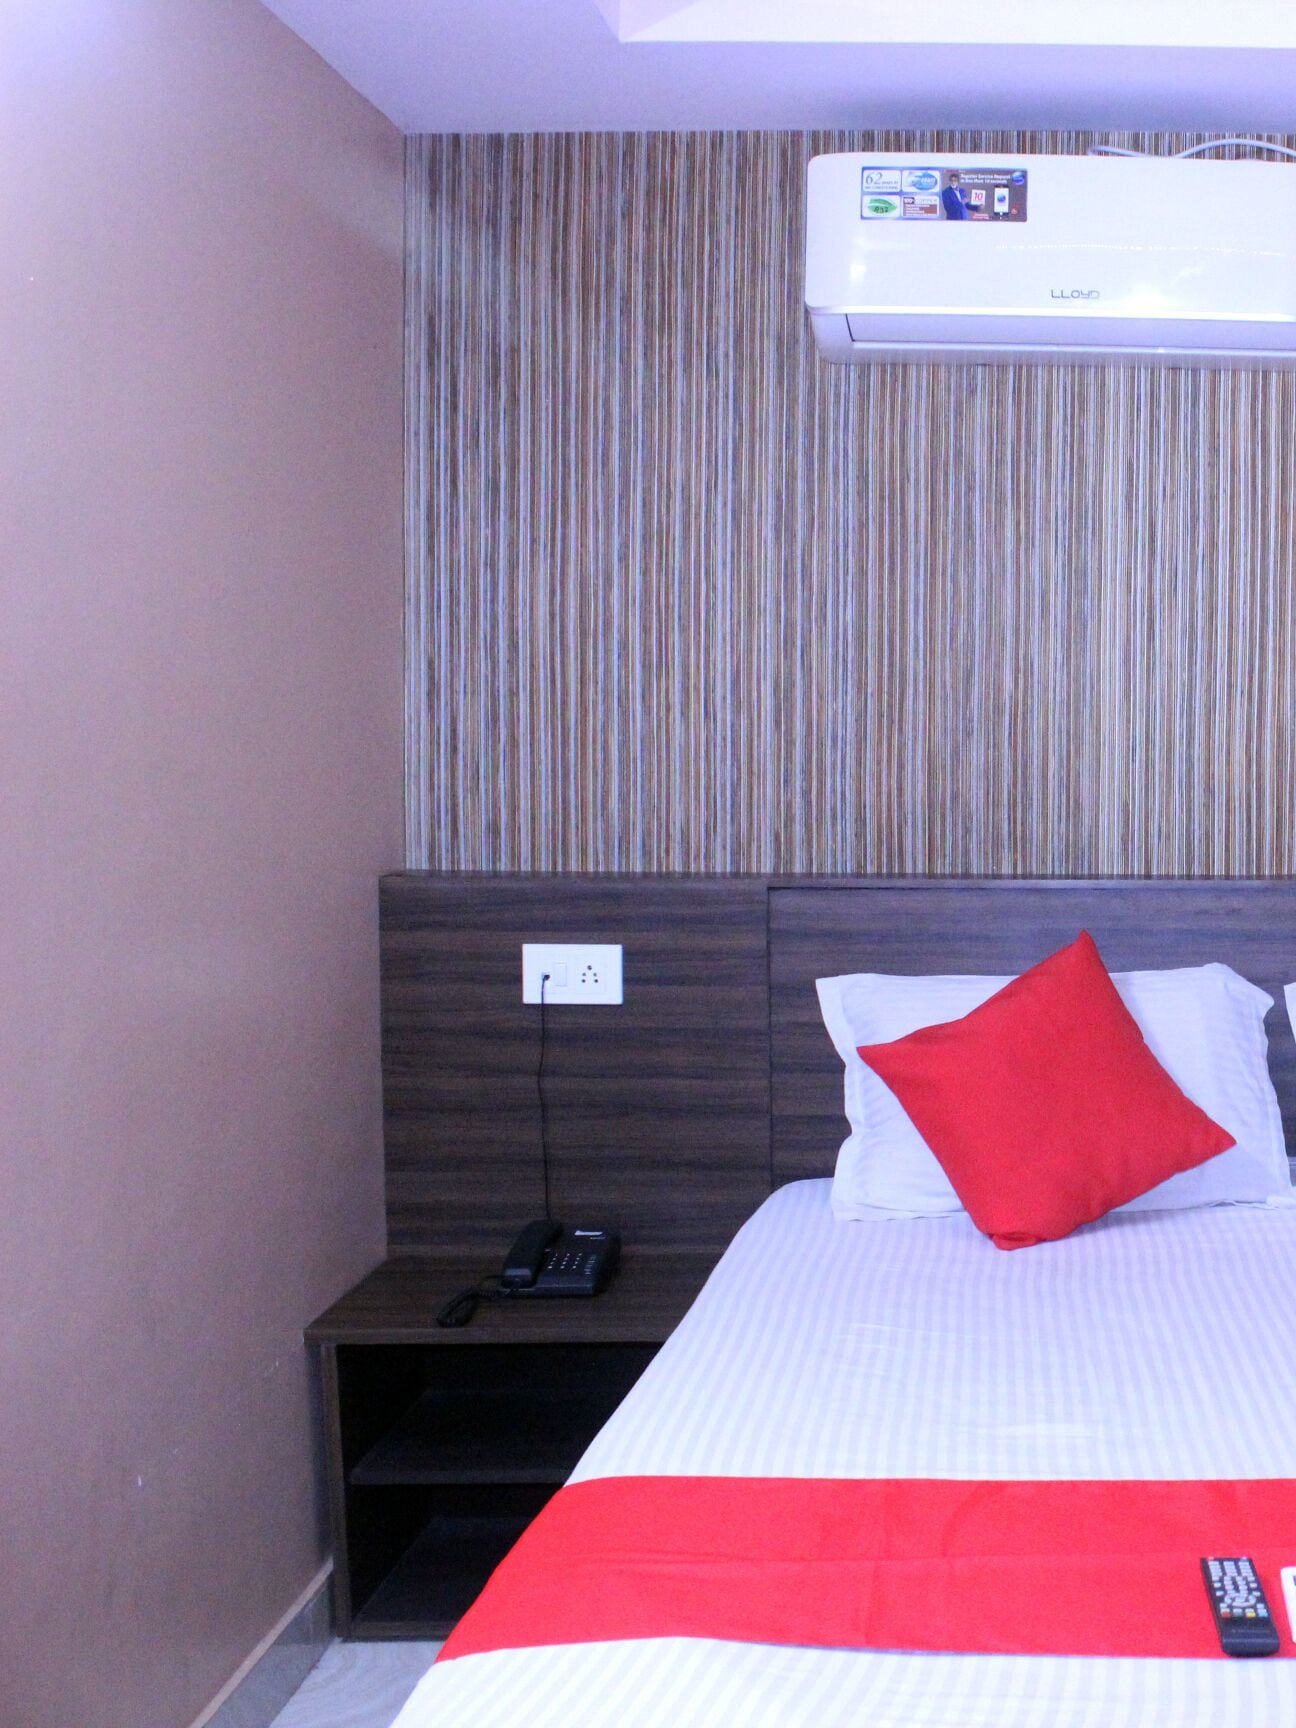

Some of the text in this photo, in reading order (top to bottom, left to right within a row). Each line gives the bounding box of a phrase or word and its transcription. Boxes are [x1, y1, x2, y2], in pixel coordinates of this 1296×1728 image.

[866, 172, 882, 184] 62
[974, 192, 983, 200] 10
[1051, 289, 1100, 299] LLOYD
